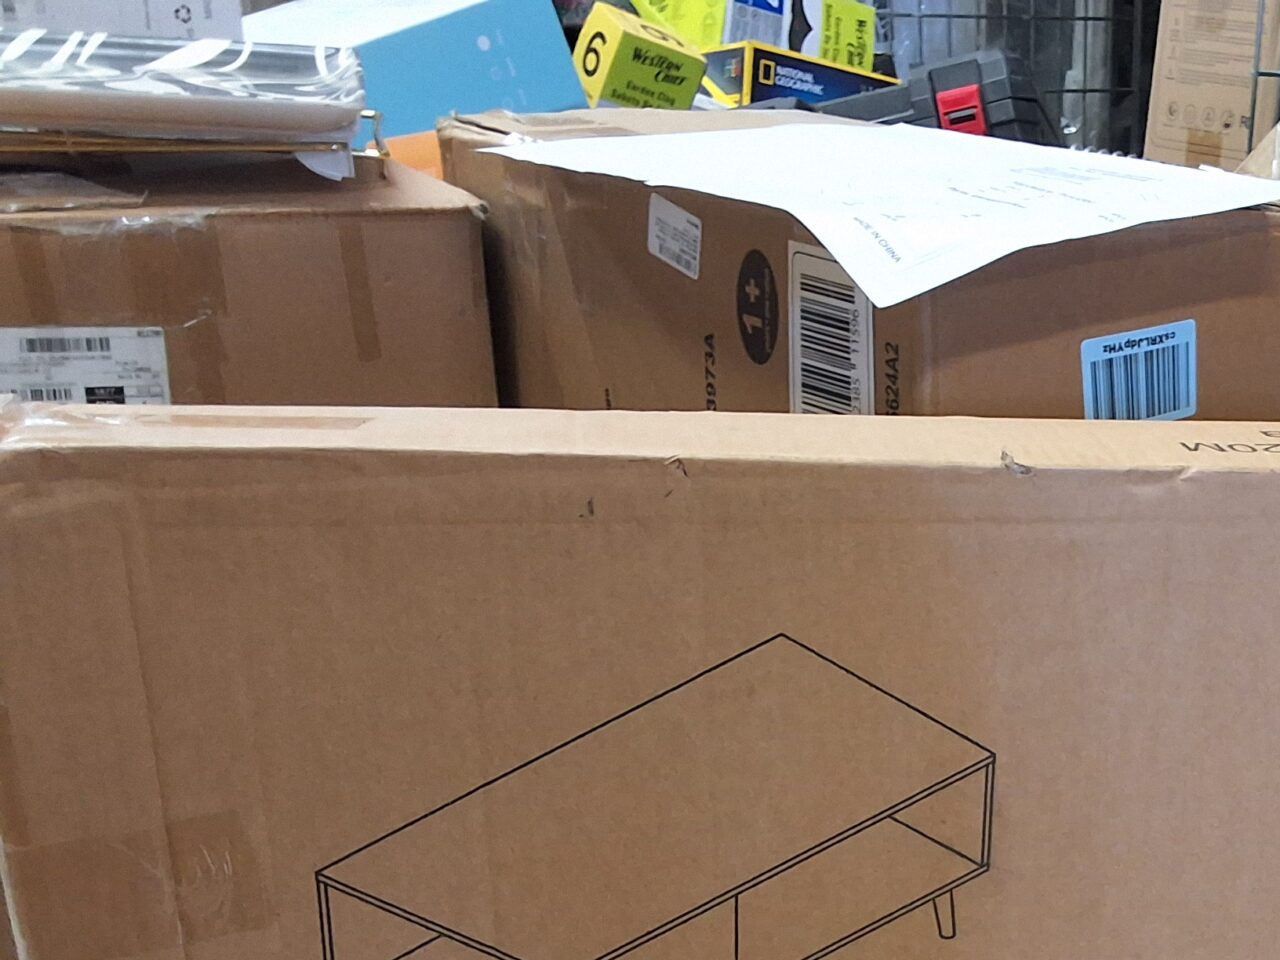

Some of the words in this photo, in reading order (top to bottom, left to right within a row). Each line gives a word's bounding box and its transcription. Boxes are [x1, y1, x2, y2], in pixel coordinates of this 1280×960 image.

[582, 31, 607, 78] 6
[775, 65, 815, 83] NATIONAL
[775, 75, 824, 96] GEOGRAPHIC
[878, 239, 902, 263] CHINA
